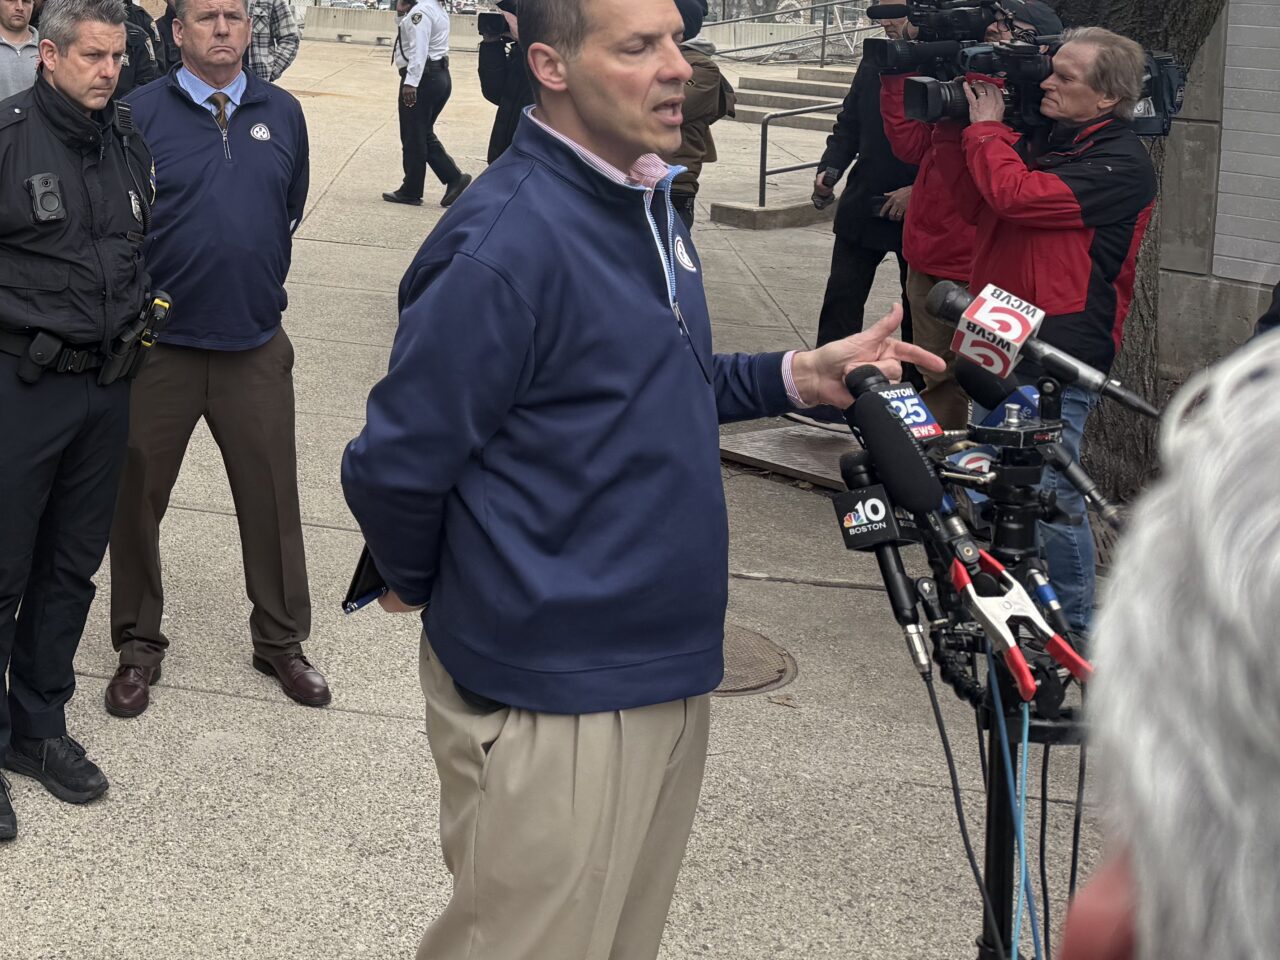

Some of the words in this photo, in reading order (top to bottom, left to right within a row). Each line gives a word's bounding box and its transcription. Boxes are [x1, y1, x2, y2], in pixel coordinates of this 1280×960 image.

[990, 288, 1038, 318] WCVB
[966, 321, 1011, 352] WCVB
[890, 397, 927, 425] 25
[854, 497, 886, 524] 10
[848, 521, 887, 535] BOSTON
